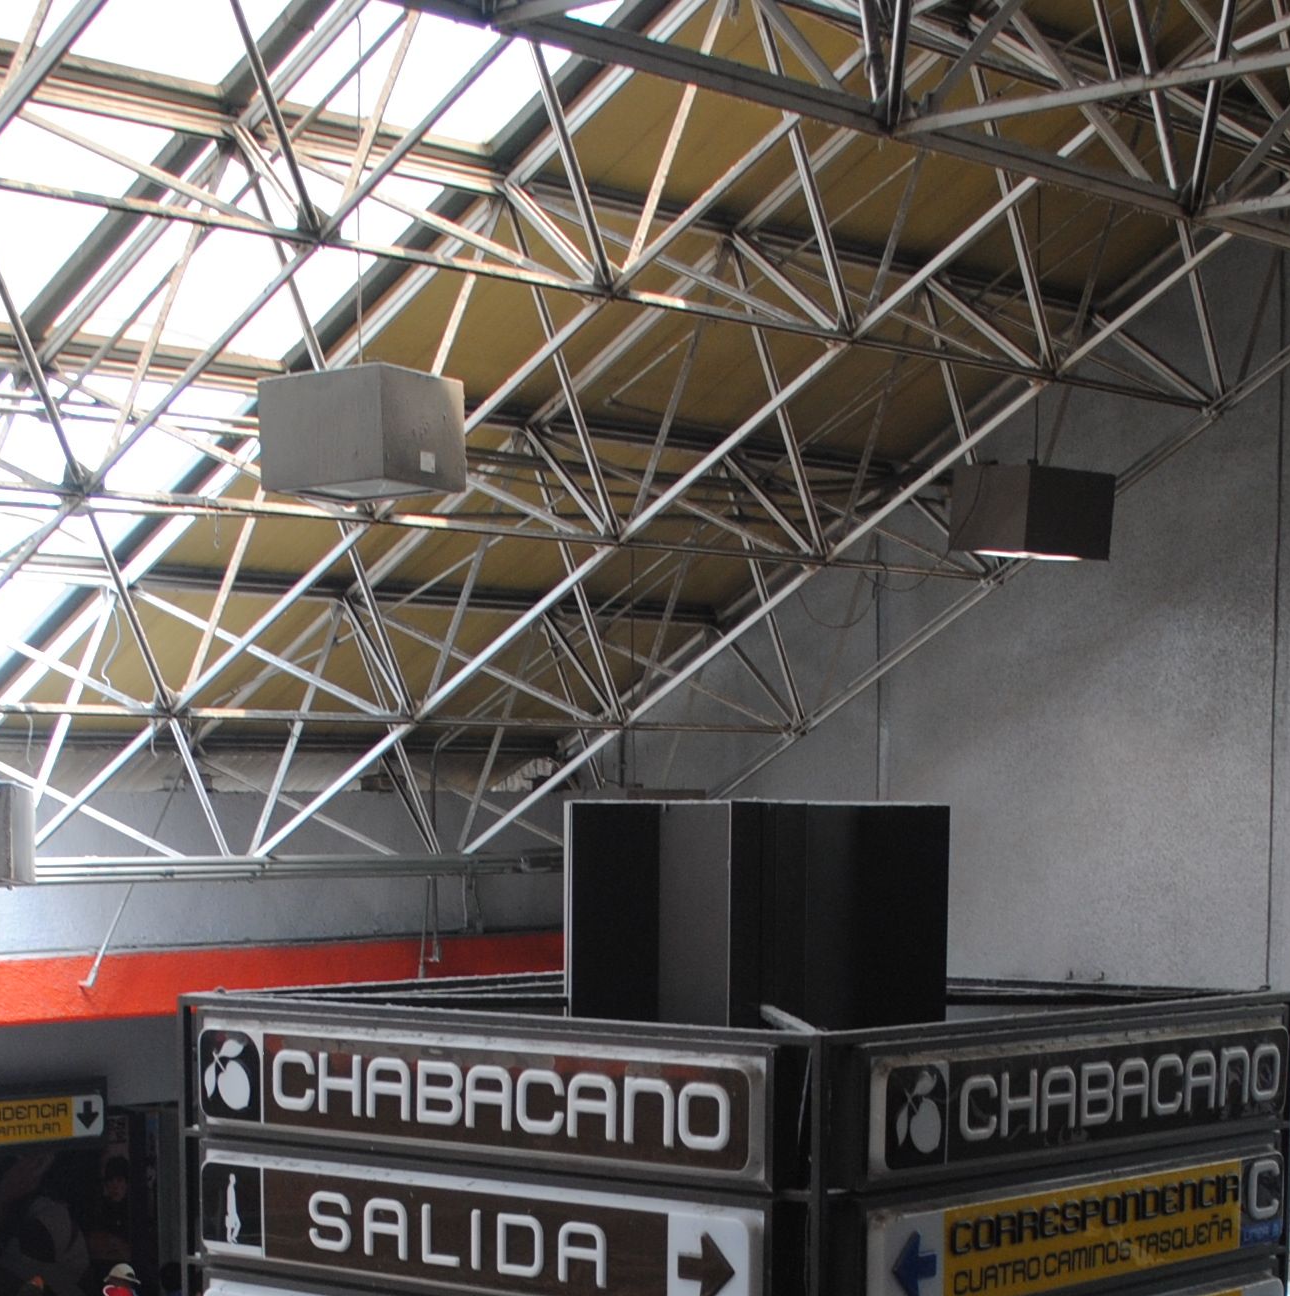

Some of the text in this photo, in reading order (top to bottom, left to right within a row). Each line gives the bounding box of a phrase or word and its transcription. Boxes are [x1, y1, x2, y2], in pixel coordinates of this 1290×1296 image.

[272, 1048, 730, 1151] CHABACANO
[959, 1043, 1280, 1142] CHABACANO
[950, 1172, 1240, 1257] CORRESPONDENCIA
[1246, 1158, 1279, 1220] C
[309, 1190, 608, 1288] SALIDA
[953, 1217, 1232, 1296] CUATRO CAMINOS TASQUEÑA
